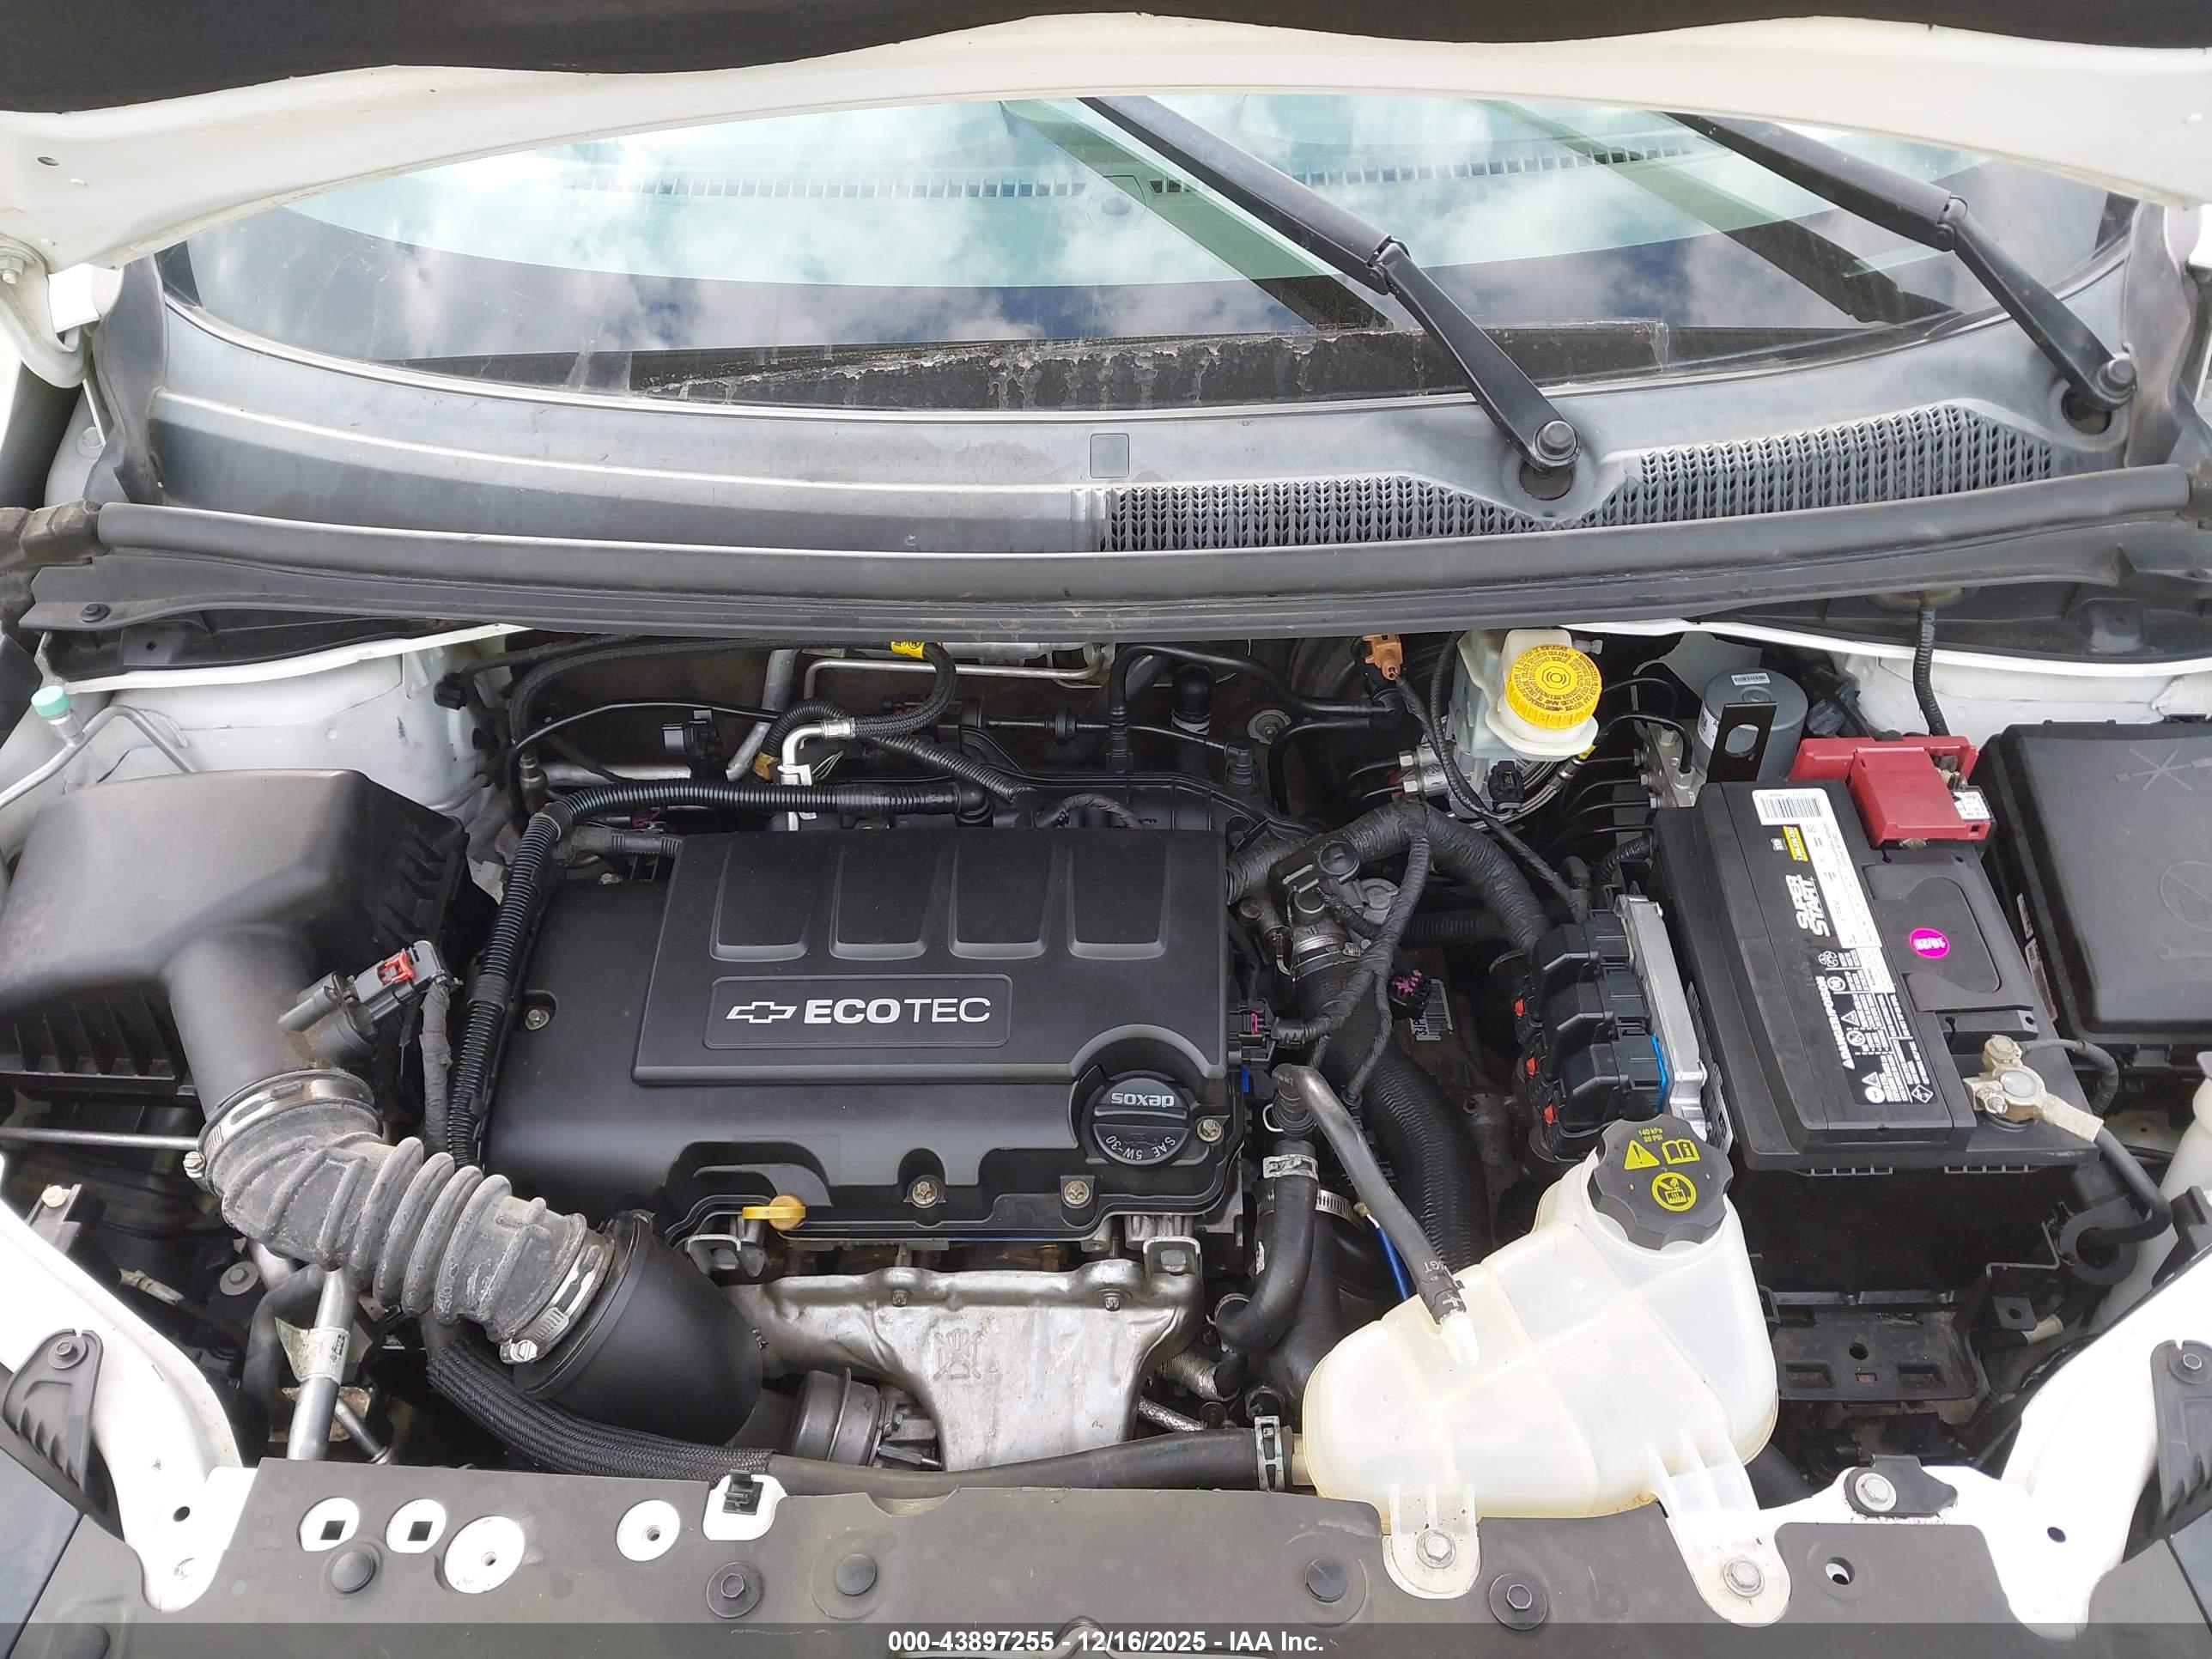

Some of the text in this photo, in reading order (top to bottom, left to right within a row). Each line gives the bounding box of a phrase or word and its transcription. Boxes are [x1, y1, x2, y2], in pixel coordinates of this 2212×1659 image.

[1785, 873, 1815, 930] SUPER
[1796, 873, 1831, 937] START
[804, 997, 991, 1024] ECOTEC
[1816, 975, 1853, 1059] DANGER/POISON
[1111, 1093, 1174, 1108] dexos
[1105, 1135, 1176, 1160] SAE 5W-30
